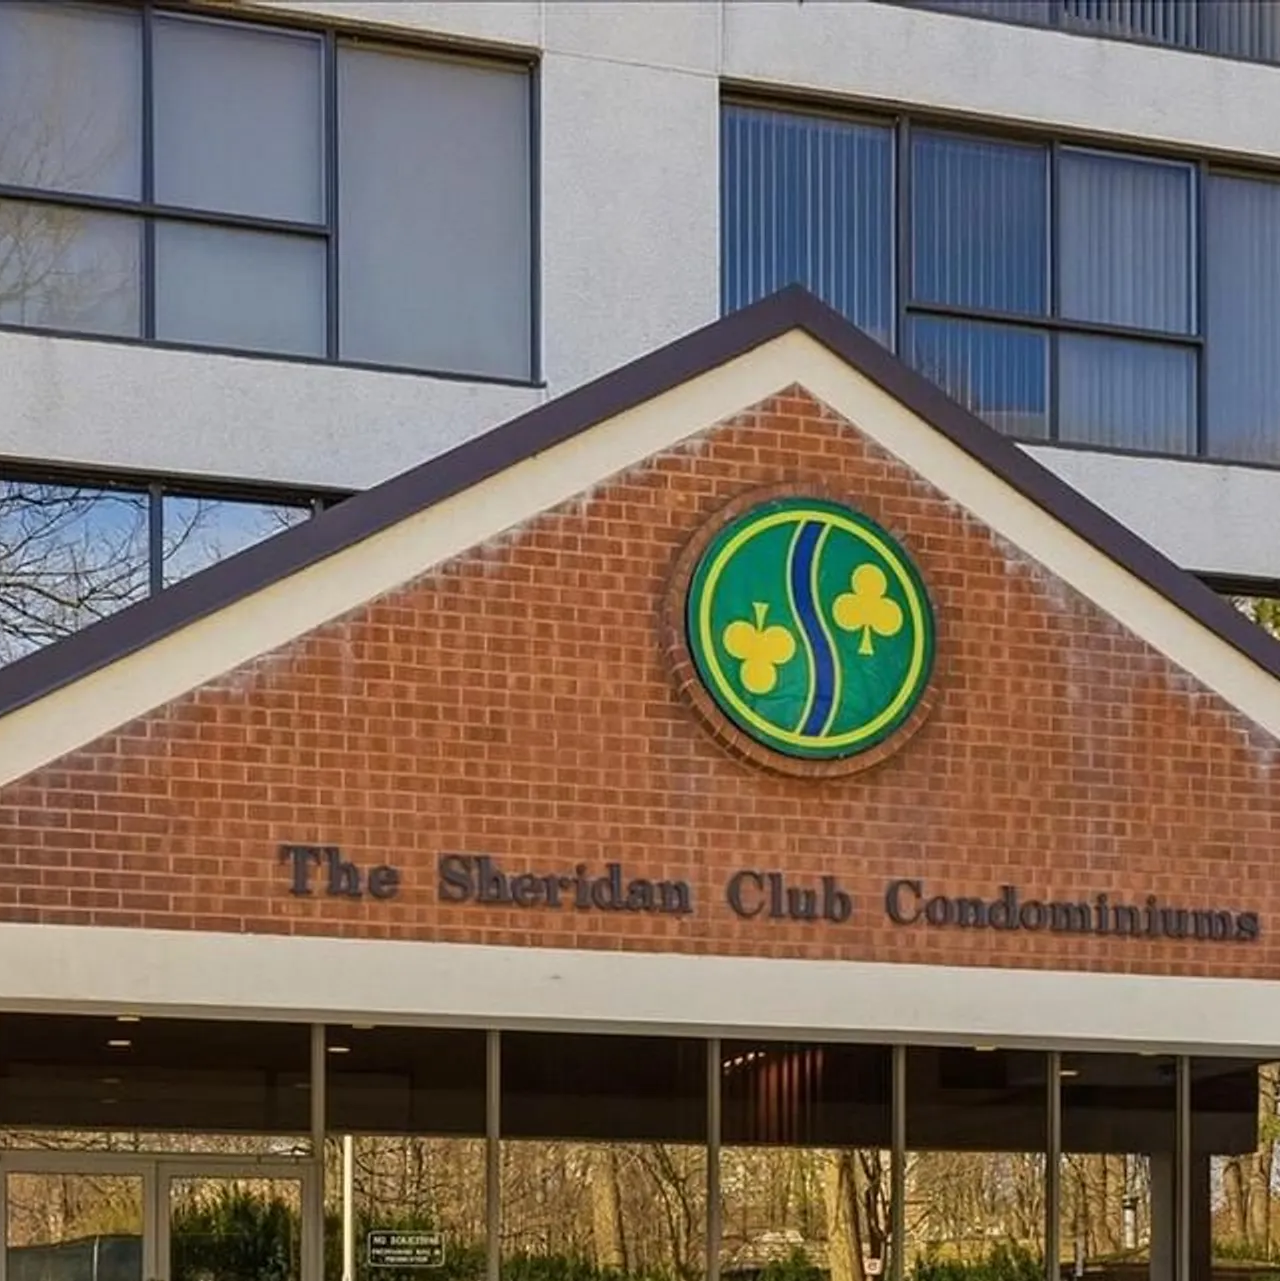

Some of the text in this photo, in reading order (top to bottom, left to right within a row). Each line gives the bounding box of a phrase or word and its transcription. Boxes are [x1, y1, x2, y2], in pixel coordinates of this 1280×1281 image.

[278, 844, 1259, 942] The Sheridan Club Condominiums
